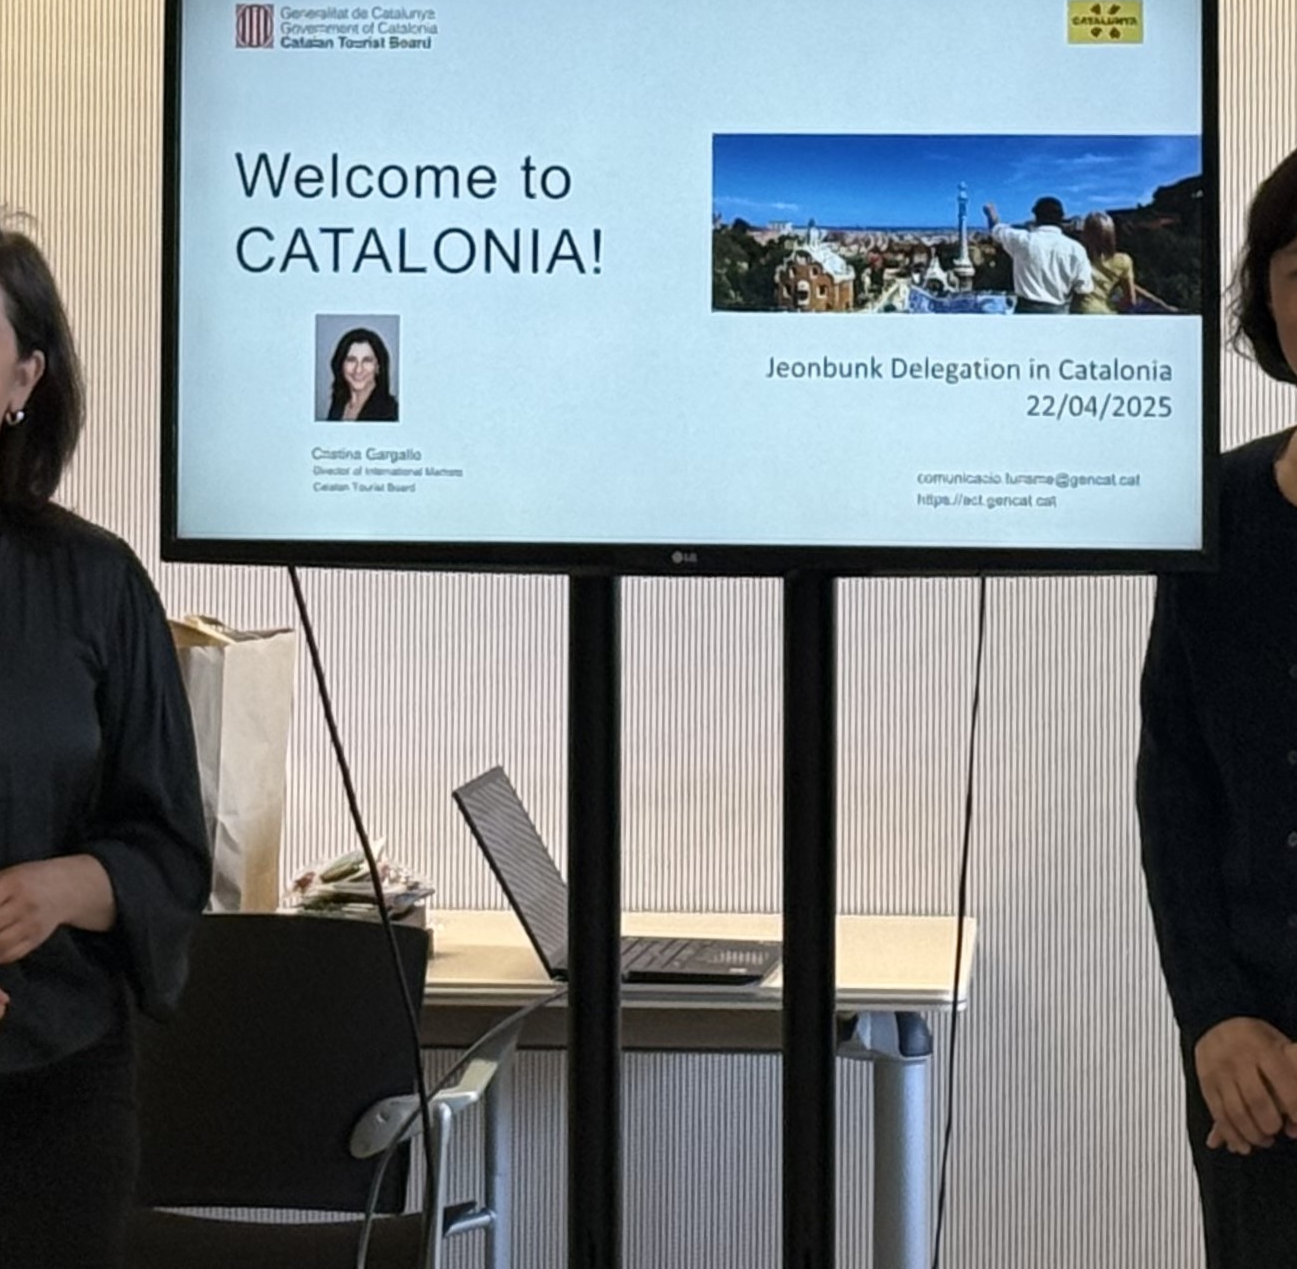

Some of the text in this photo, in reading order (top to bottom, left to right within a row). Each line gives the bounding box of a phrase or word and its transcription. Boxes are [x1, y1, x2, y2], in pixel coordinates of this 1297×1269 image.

[280, 6, 436, 22] Generalitat de Catalunya
[362, 21, 375, 35] of
[378, 21, 438, 35] Catalonia
[280, 36, 432, 49] Catalan Tourist Board
[235, 152, 571, 199] Welcome to
[236, 226, 602, 275] CATALONIA!
[766, 356, 1173, 384] Jeonbunk Delegation in Catalonia
[1026, 394, 1173, 421] 22/04/2025
[366, 447, 422, 463] Gargallo
